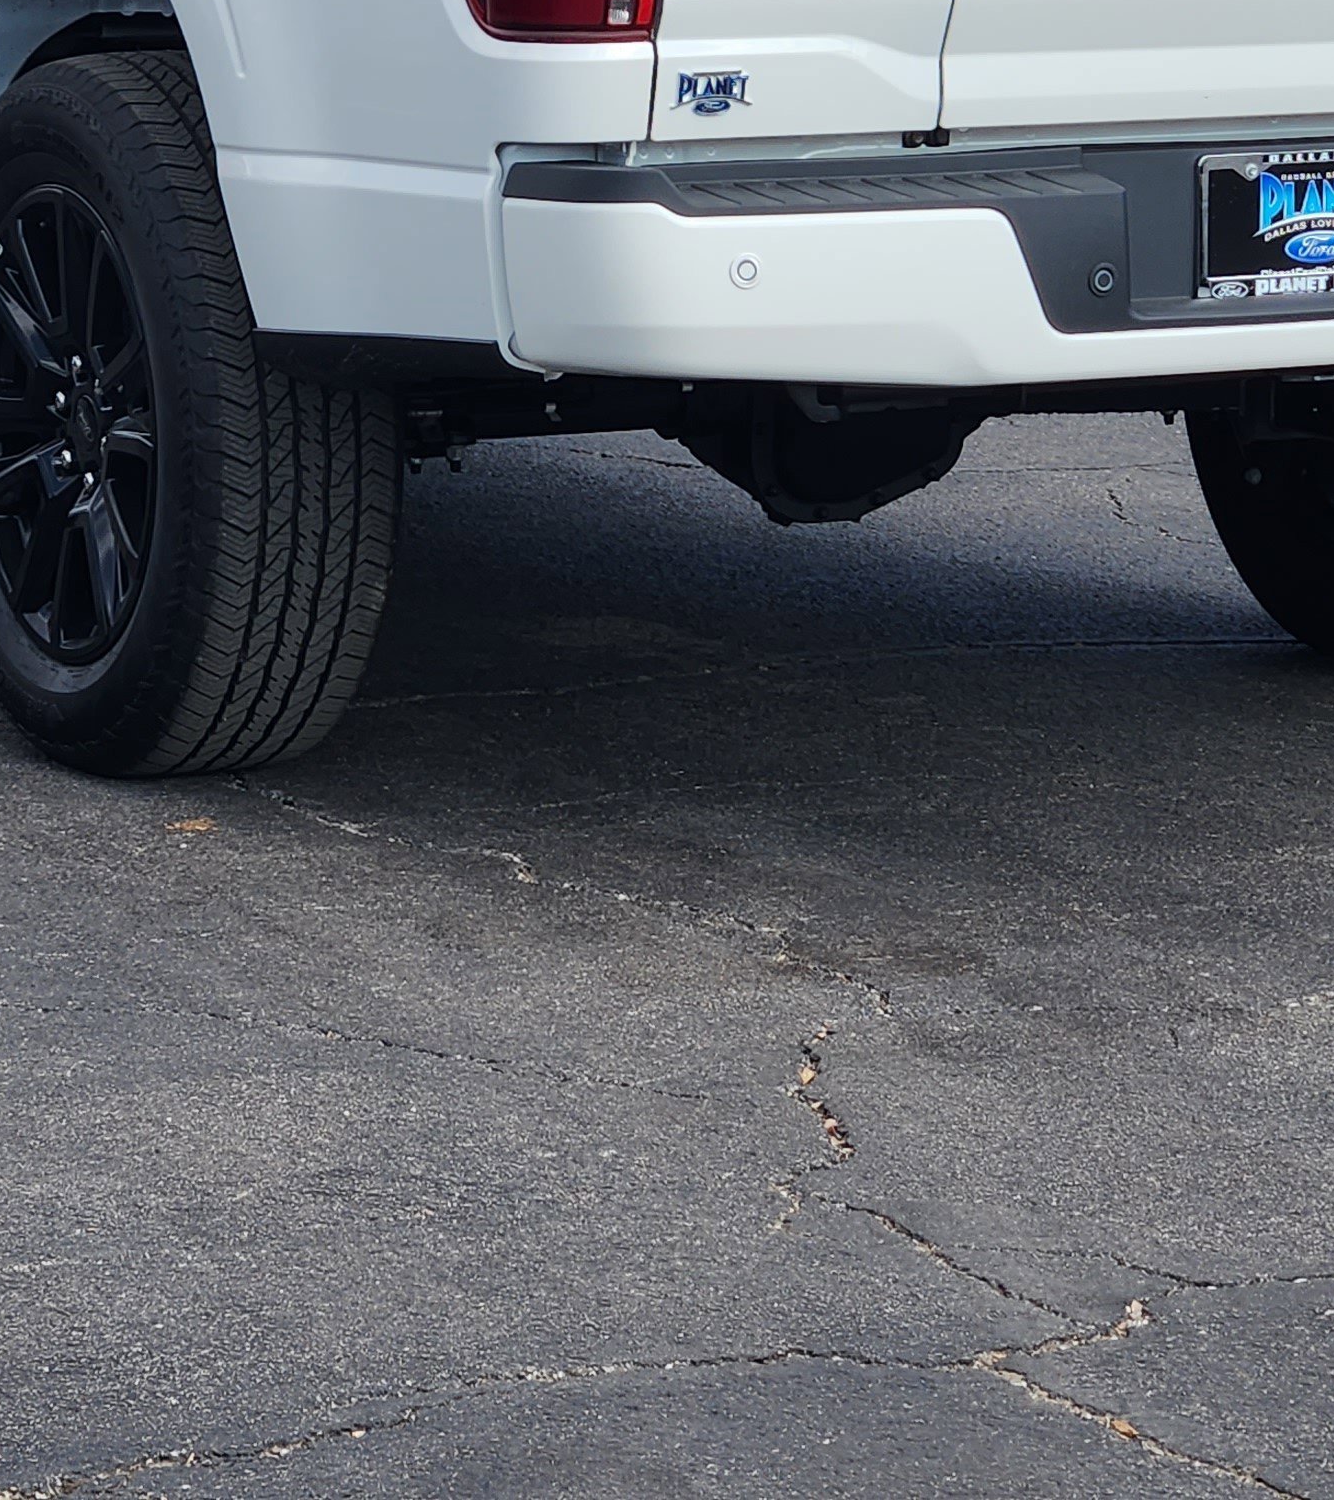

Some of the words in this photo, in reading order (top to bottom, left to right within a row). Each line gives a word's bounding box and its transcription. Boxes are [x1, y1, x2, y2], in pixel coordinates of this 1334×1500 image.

[678, 72, 750, 104] PLANET
[1264, 221, 1308, 242] DALLAS
[1255, 275, 1329, 297] PLANET
